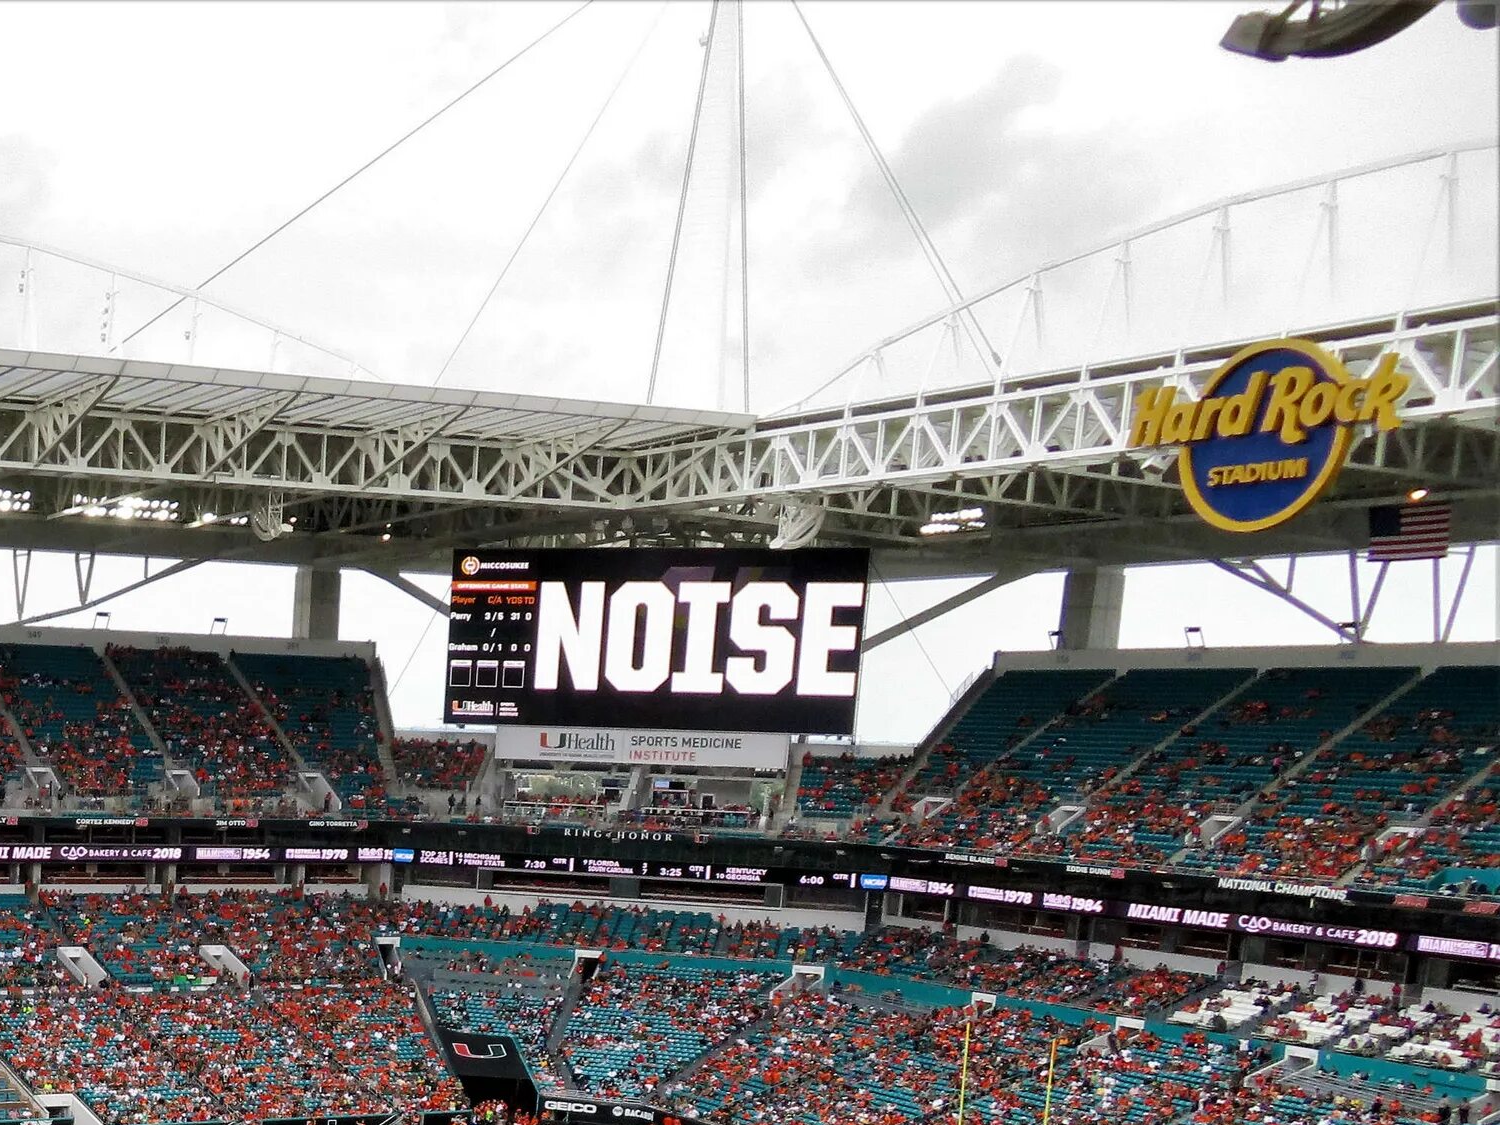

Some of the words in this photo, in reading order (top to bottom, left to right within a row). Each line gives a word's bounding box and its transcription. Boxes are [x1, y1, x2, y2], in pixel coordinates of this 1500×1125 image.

[1127, 369, 1269, 448] Hard
[1261, 351, 1412, 444] Rock
[1207, 457, 1308, 487] STADIUM
[450, 612, 471, 621] Perry
[510, 612, 520, 620] 31
[525, 612, 532, 620] 0
[534, 581, 865, 696] NOISE
[449, 643, 478, 651] Graham
[540, 732, 615, 751] UHealth
[631, 736, 678, 747] SPORTS
[681, 737, 742, 749] MEDICINE
[629, 751, 696, 762] INSTITUTE
[564, 828, 601, 838] RING
[617, 831, 673, 842] HONOR
[12, 846, 52, 859] MADE
[89, 849, 119, 857] BAKERY
[152, 848, 182, 859] 2018
[243, 849, 270, 860] 1954
[321, 849, 348, 860] 1978
[483, 860, 505, 868] STATE
[524, 860, 546, 869] 7:30
[553, 858, 568, 866] QTR
[969, 856, 994, 864] BLADES
[608, 867, 633, 875] CAROLINA
[659, 867, 682, 877] 3:25
[689, 865, 704, 873] QTR
[726, 867, 767, 876] KENTUCKY
[1066, 865, 1088, 874] EDDIE
[1089, 867, 1110, 876] DUNN
[726, 873, 761, 882] GEORGIA
[800, 875, 824, 885] 6:00
[928, 881, 954, 895] 1954
[1218, 877, 1272, 892] NATIONAL
[1274, 882, 1347, 901] CHAMPIONS
[1005, 889, 1033, 905] 1978
[1071, 898, 1103, 913] 1984
[1128, 903, 1180, 922] MIAMI
[1183, 908, 1228, 928] MADE
[1273, 922, 1312, 936] BAKERY
[1316, 926, 1324, 937] &
[1326, 928, 1355, 941] CAFE
[1355, 928, 1397, 947] 2018
[452, 1042, 507, 1060] U
[544, 1101, 597, 1114] GEICO
